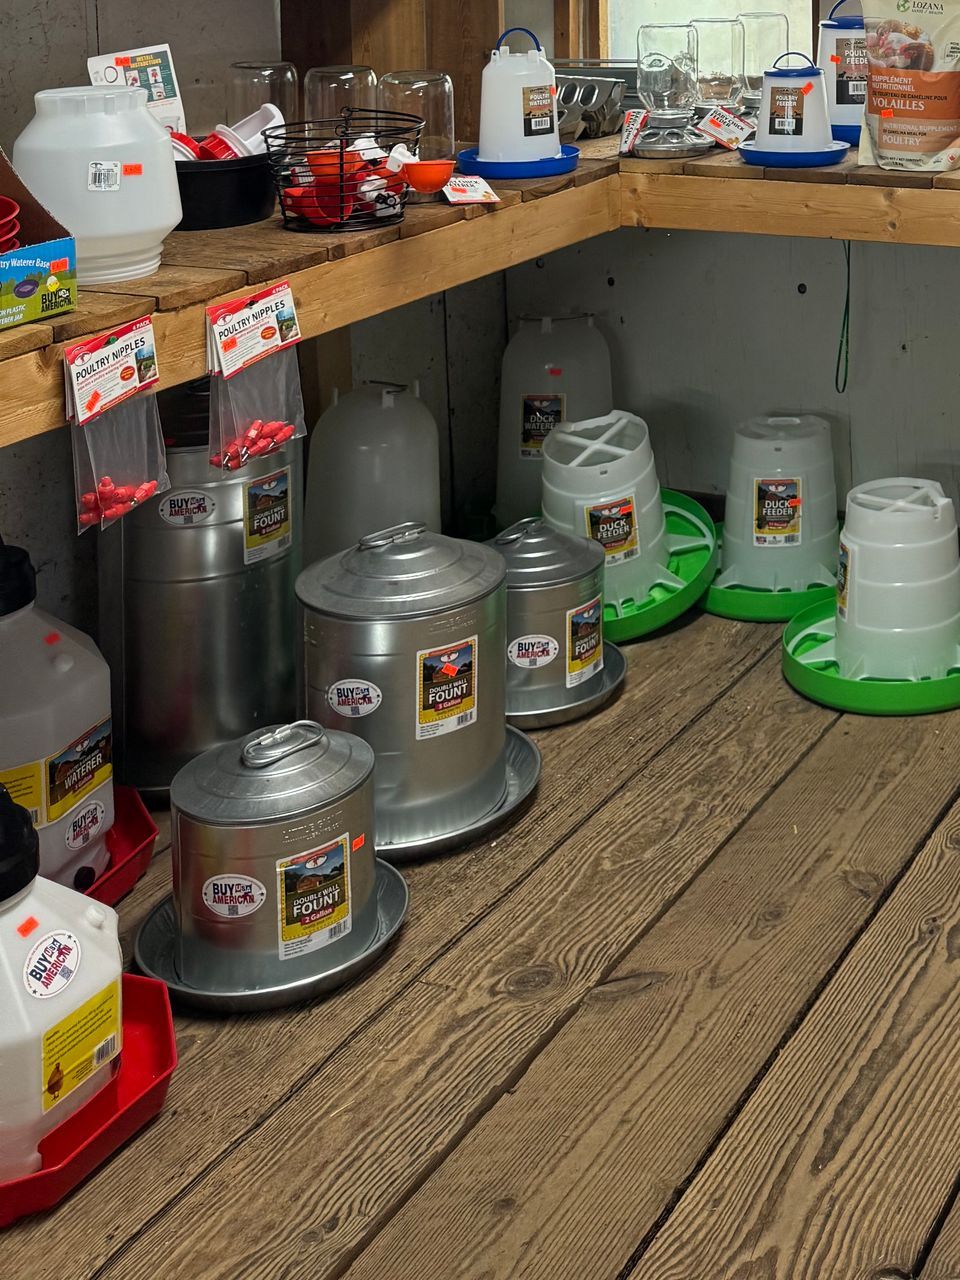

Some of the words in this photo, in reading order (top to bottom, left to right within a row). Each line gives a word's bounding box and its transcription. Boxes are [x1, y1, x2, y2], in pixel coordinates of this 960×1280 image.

[912, 0, 944, 11] LOZANA
[871, 74, 913, 85] SUPPLÉMENT
[872, 83, 915, 92] NUTRITIONNEL
[872, 97, 925, 111] VOLAILLES
[919, 124, 958, 132] SUPPLEMENT
[882, 135, 921, 146] POULTRY
[11, 257, 35, 267] Waterer
[35, 257, 50, 268] Base
[276, 283, 289, 293] PACK
[41, 288, 59, 305] BUY
[41, 298, 72, 312] AMERICAN
[137, 319, 150, 329] PACK
[218, 315, 251, 341] POULTRY
[251, 299, 286, 322] NIPPLES
[75, 353, 111, 382] POULTRY
[111, 336, 146, 362] NIPPLES
[530, 415, 555, 423] DUCK
[169, 498, 190, 509] BUY
[765, 500, 791, 509] DUCK
[168, 505, 208, 517] AMERICAN
[763, 507, 793, 516] FEEDER
[254, 509, 286, 530] FOUNT
[599, 518, 627, 532] DUCK
[597, 525, 630, 540] FEEDER
[517, 642, 536, 652] BUY
[516, 649, 551, 659] AMERICAN
[429, 682, 452, 695] DOUBLE
[452, 677, 467, 688] WALL
[336, 687, 355, 699] BUY
[428, 682, 468, 705] FOUNT
[336, 696, 373, 707] AMERICAN
[64, 753, 103, 790] WATERER
[72, 812, 87, 833] BUY
[72, 815, 99, 843] AMERICAN
[213, 882, 235, 895] BUY
[293, 889, 323, 907] DOUBLE
[323, 883, 340, 896] WALL
[212, 894, 255, 905] AMERICAN
[293, 889, 341, 918] FOUNT
[305, 915, 311, 923] 2
[311, 907, 333, 921] Gallon
[29, 952, 52, 982] BUY
[40, 943, 73, 990] AMERICAN
